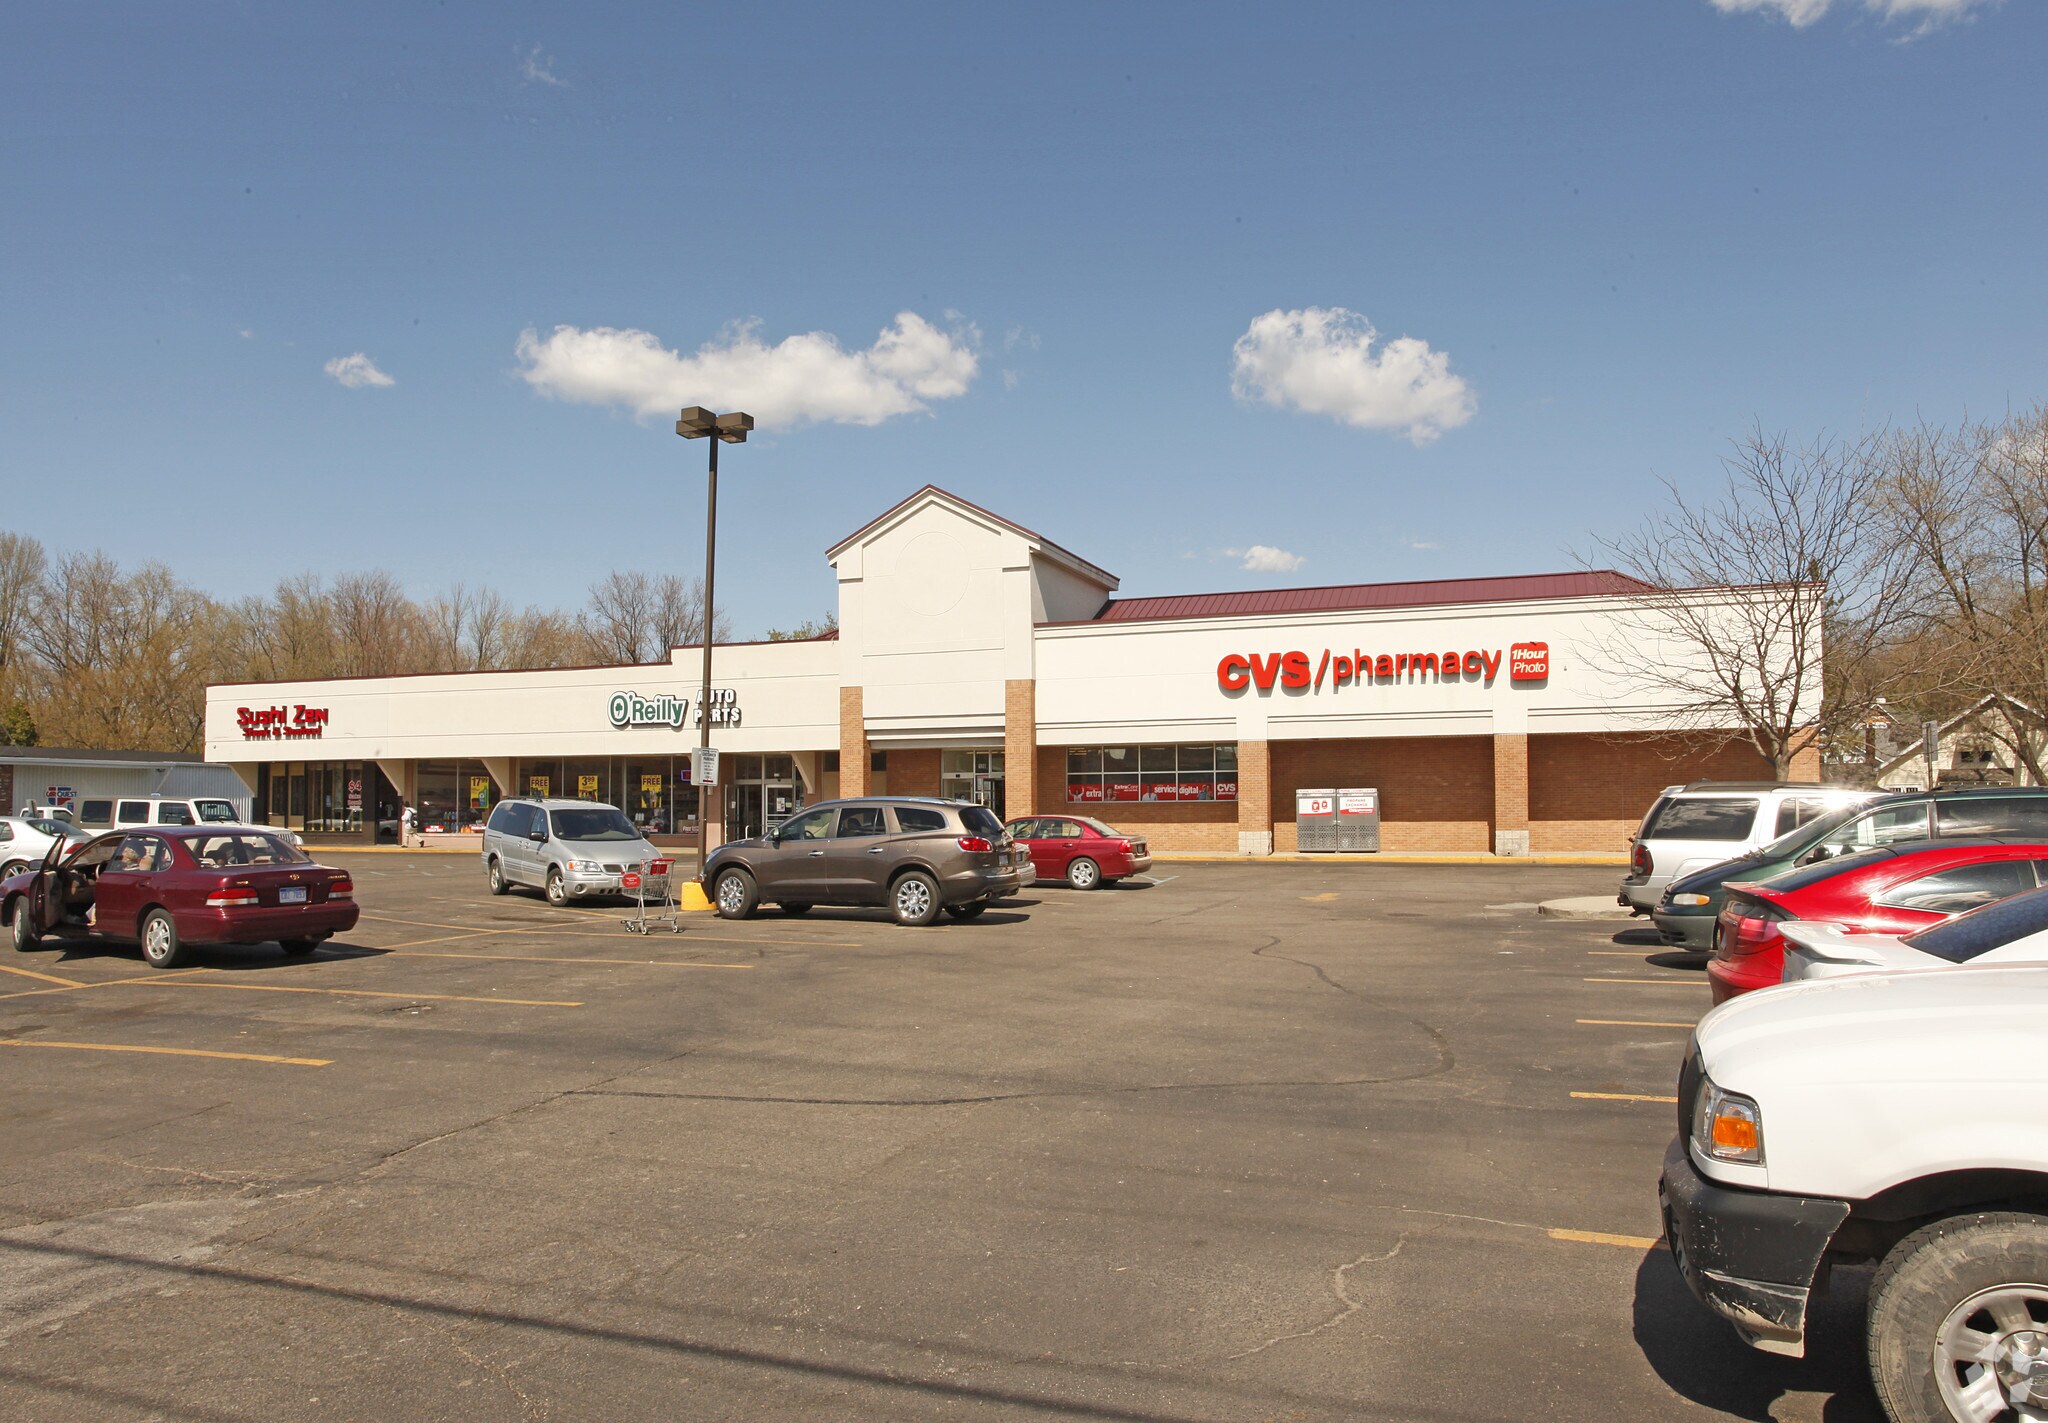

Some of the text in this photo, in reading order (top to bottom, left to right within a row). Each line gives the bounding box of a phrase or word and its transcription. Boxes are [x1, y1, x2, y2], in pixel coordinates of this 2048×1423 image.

[1512, 649, 1547, 660] 1Hour
[1513, 662, 1546, 673] Photo
[609, 693, 686, 725] O'Reilly
[236, 706, 287, 726] Sushi
[693, 707, 741, 723] PRTS
[348, 780, 362, 792] $4
[642, 778, 661, 786] FREE
[1217, 783, 1236, 792] CVS
[1085, 789, 1102, 798] extra
[1154, 785, 1176, 793] service
[1179, 786, 1199, 795] digital
